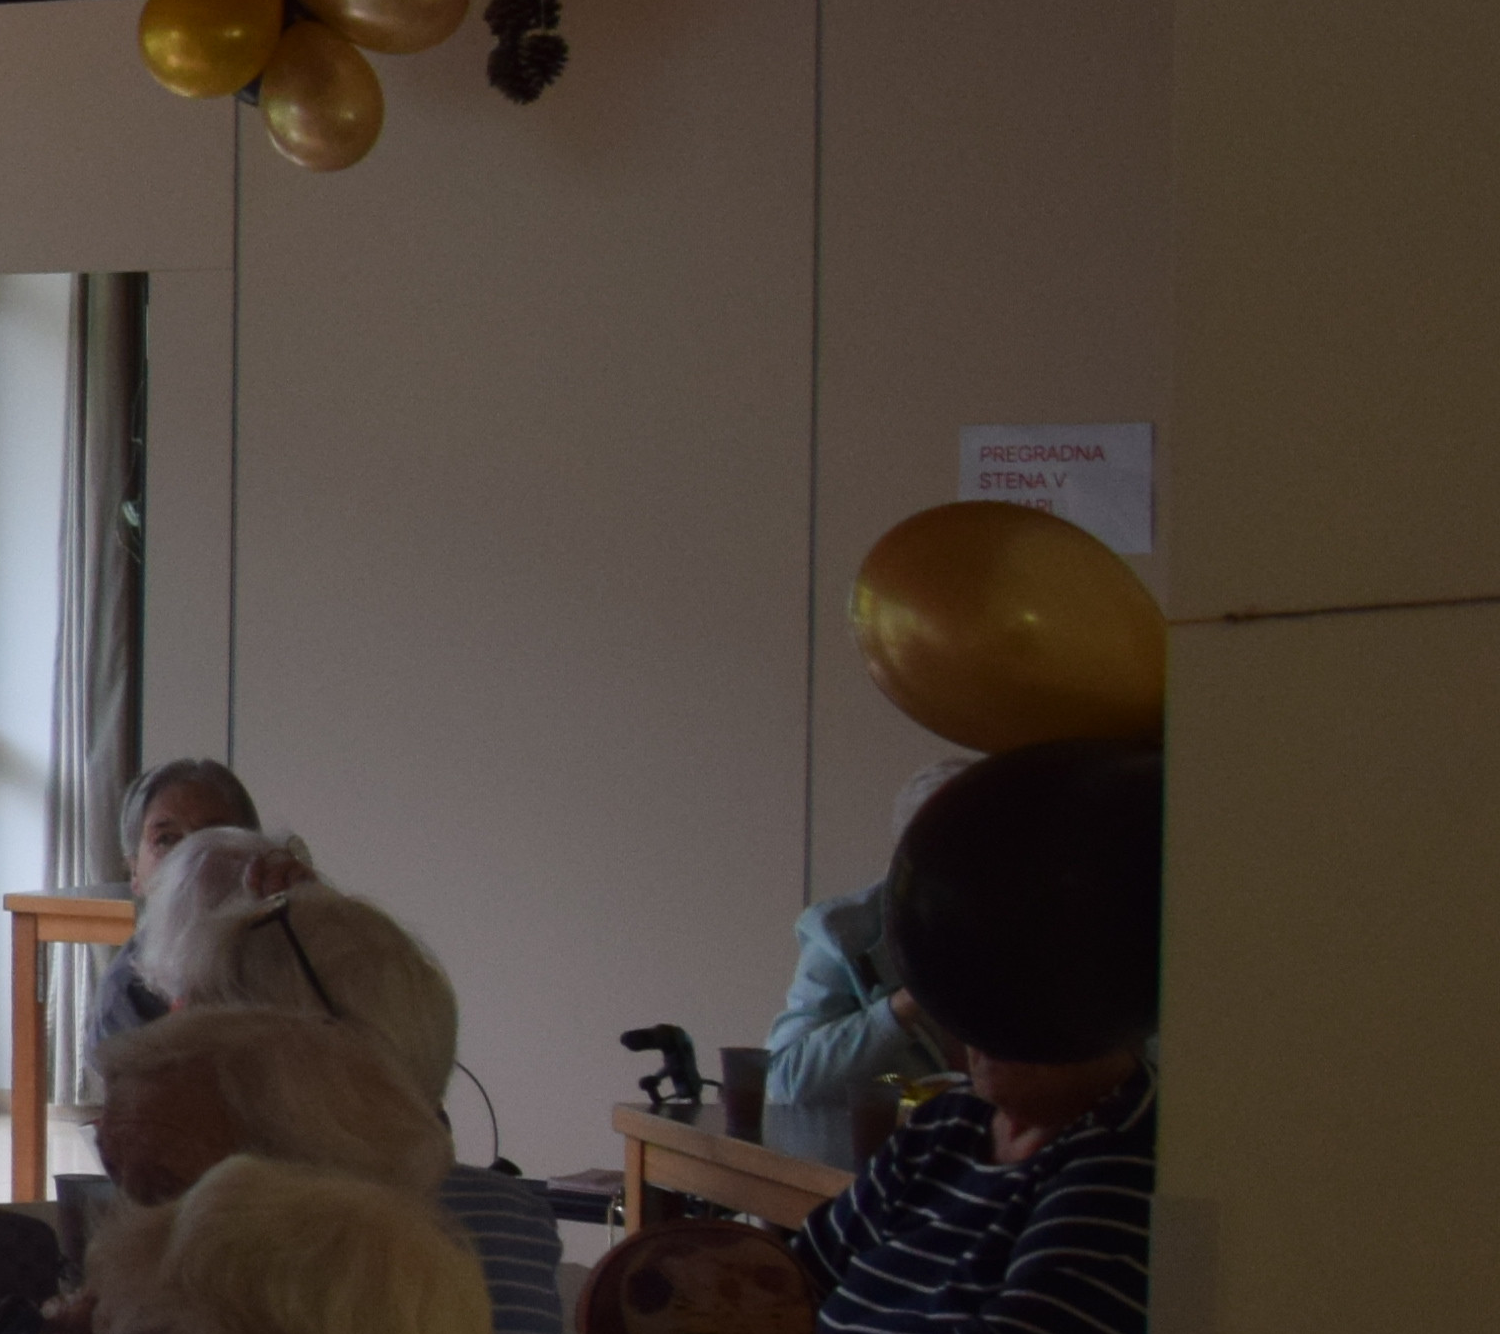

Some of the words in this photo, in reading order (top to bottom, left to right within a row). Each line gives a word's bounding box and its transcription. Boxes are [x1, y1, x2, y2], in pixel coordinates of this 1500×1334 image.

[980, 445, 1105, 463] PREGRADNA
[980, 472, 1048, 489] STENA
[1054, 472, 1067, 488] V
